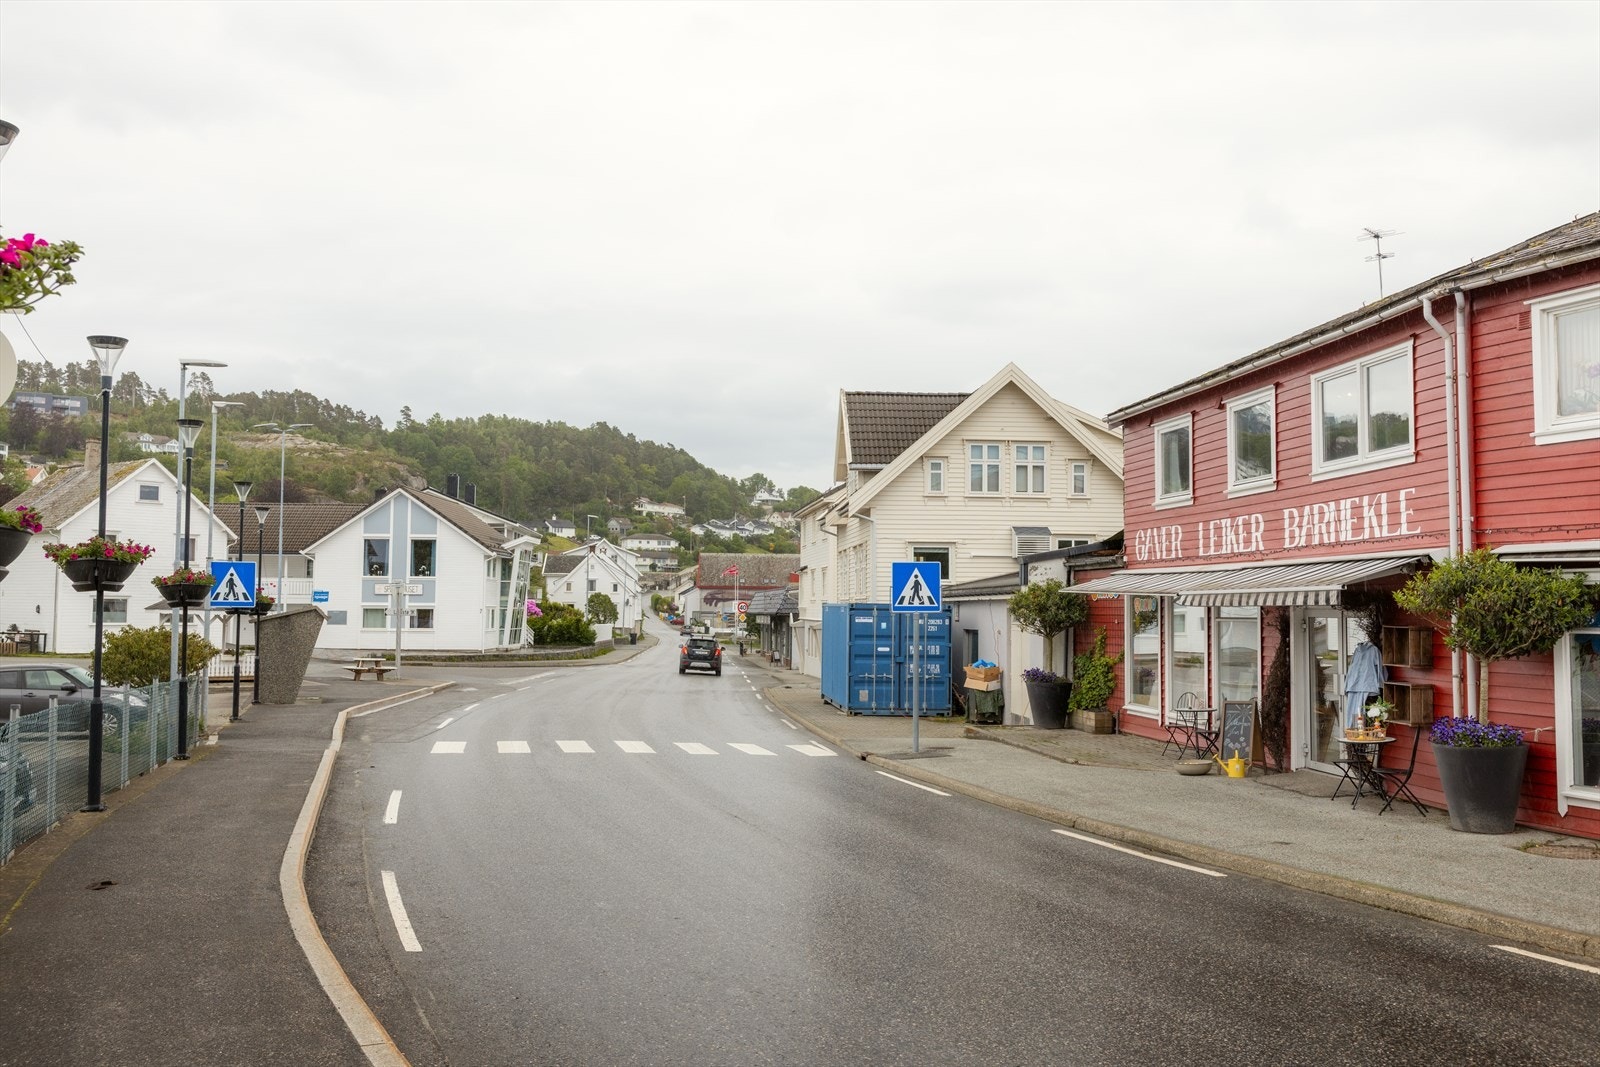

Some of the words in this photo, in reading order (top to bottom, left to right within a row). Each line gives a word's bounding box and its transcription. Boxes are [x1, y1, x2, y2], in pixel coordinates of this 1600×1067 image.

[1135, 525, 1182, 560] GAVER
[1199, 513, 1265, 556] LEIKER
[1283, 488, 1421, 549] BARNEKLE
